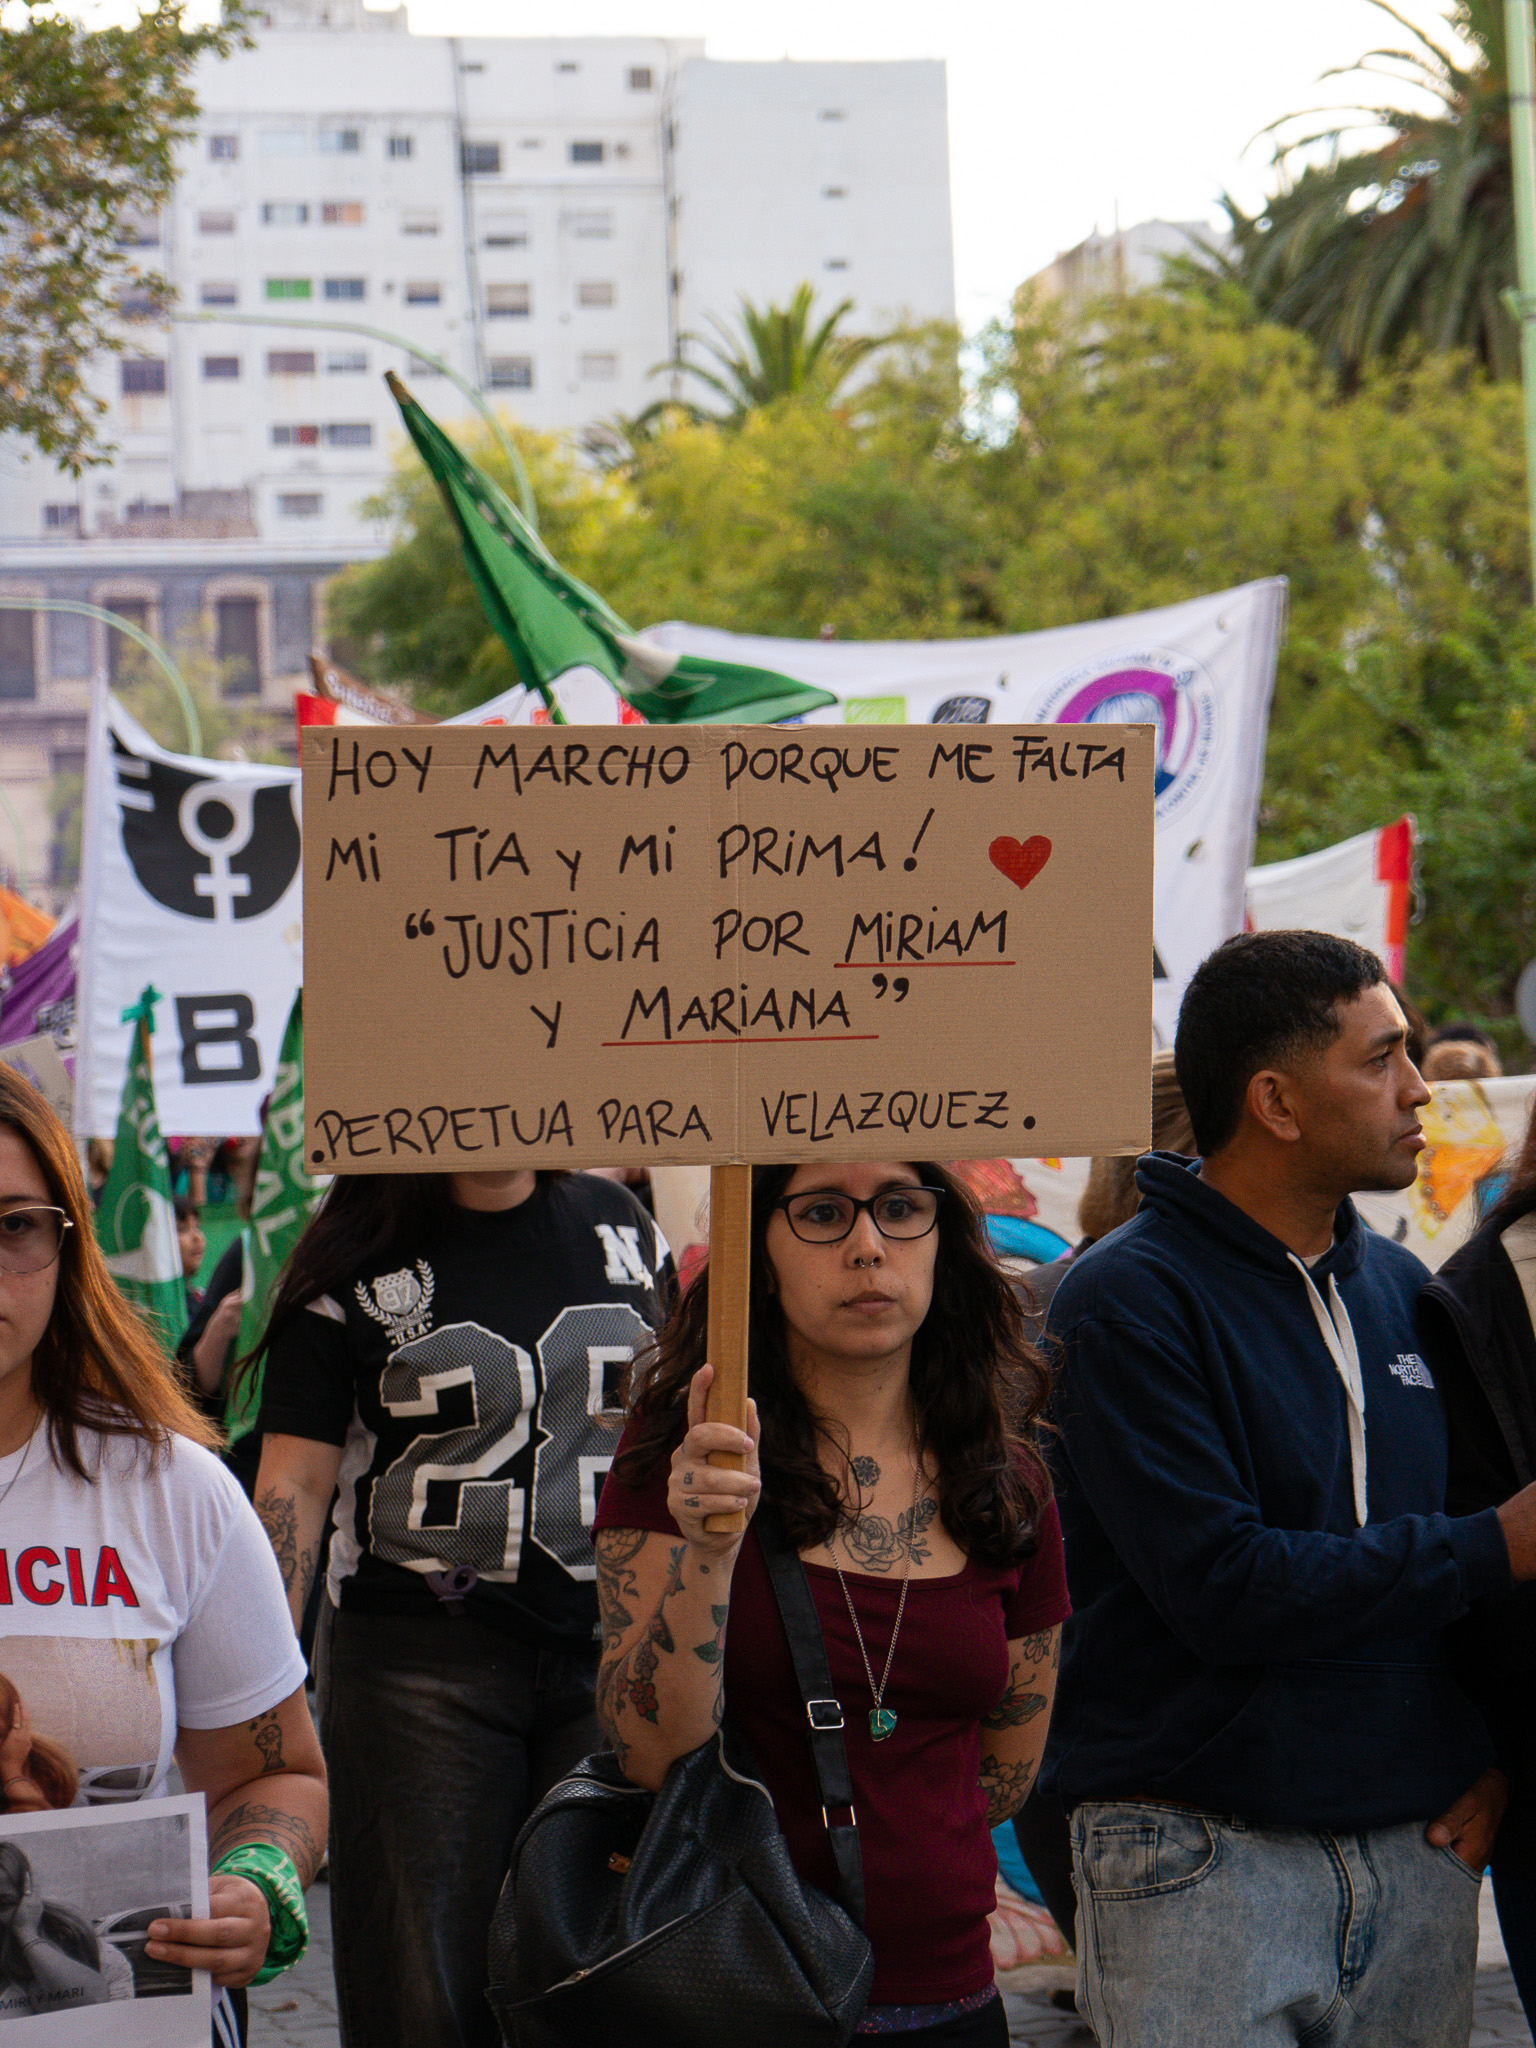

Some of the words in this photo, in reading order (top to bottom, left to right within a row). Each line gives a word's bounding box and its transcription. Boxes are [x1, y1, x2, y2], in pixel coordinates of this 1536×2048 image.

[328, 737, 433, 802] HOY
[473, 743, 691, 796] MARCHO
[719, 740, 900, 794] PORQUE
[928, 742, 996, 784] ME
[1012, 735, 1126, 783] FALTA
[711, 908, 811, 960] POR
[529, 1000, 562, 1049] Y
[596, 1098, 713, 1146] PARA
[1388, 1363, 1419, 1376] NORTH
[1396, 1353, 1418, 1365] THE
[1400, 1374, 1424, 1387] FACE
[47, 1986, 85, 2002] MARI
